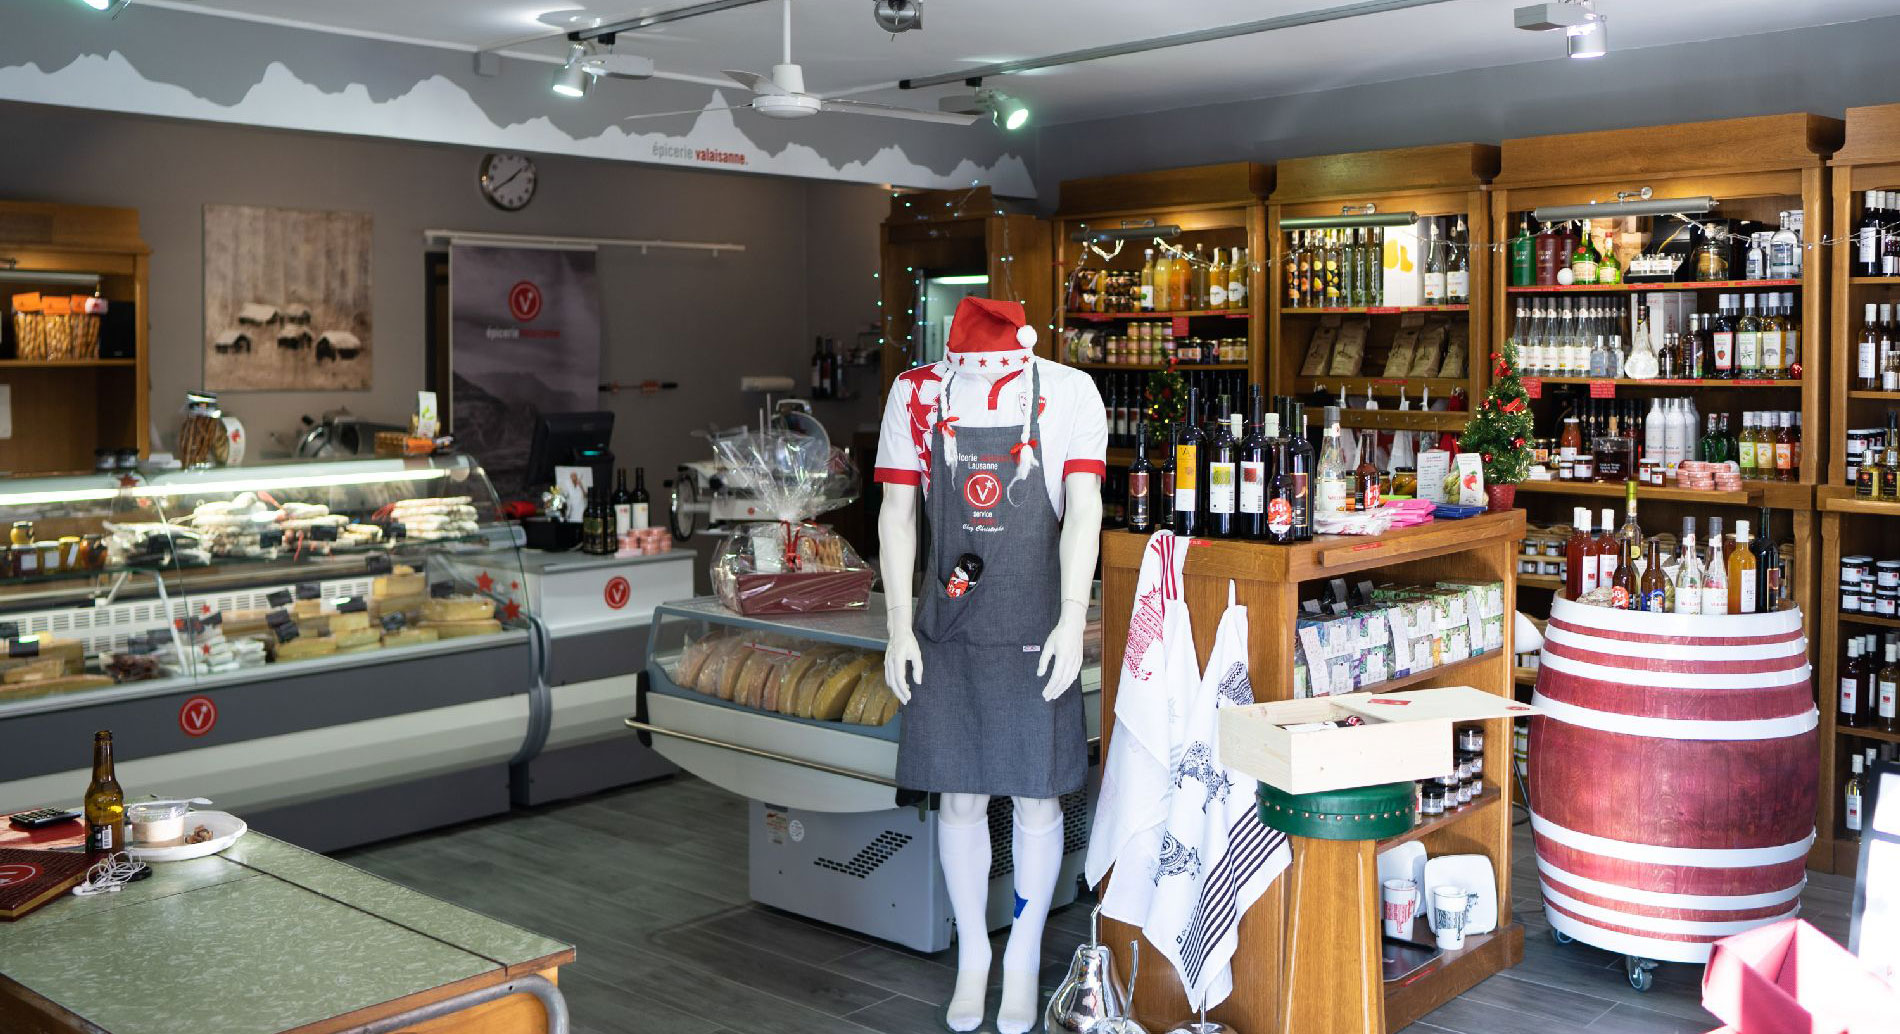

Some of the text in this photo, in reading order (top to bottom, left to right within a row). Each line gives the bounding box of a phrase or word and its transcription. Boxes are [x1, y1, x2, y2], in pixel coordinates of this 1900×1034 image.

[652, 141, 693, 160] épicerie
[968, 462, 998, 470] Lausanne
[973, 510, 993, 518] service
